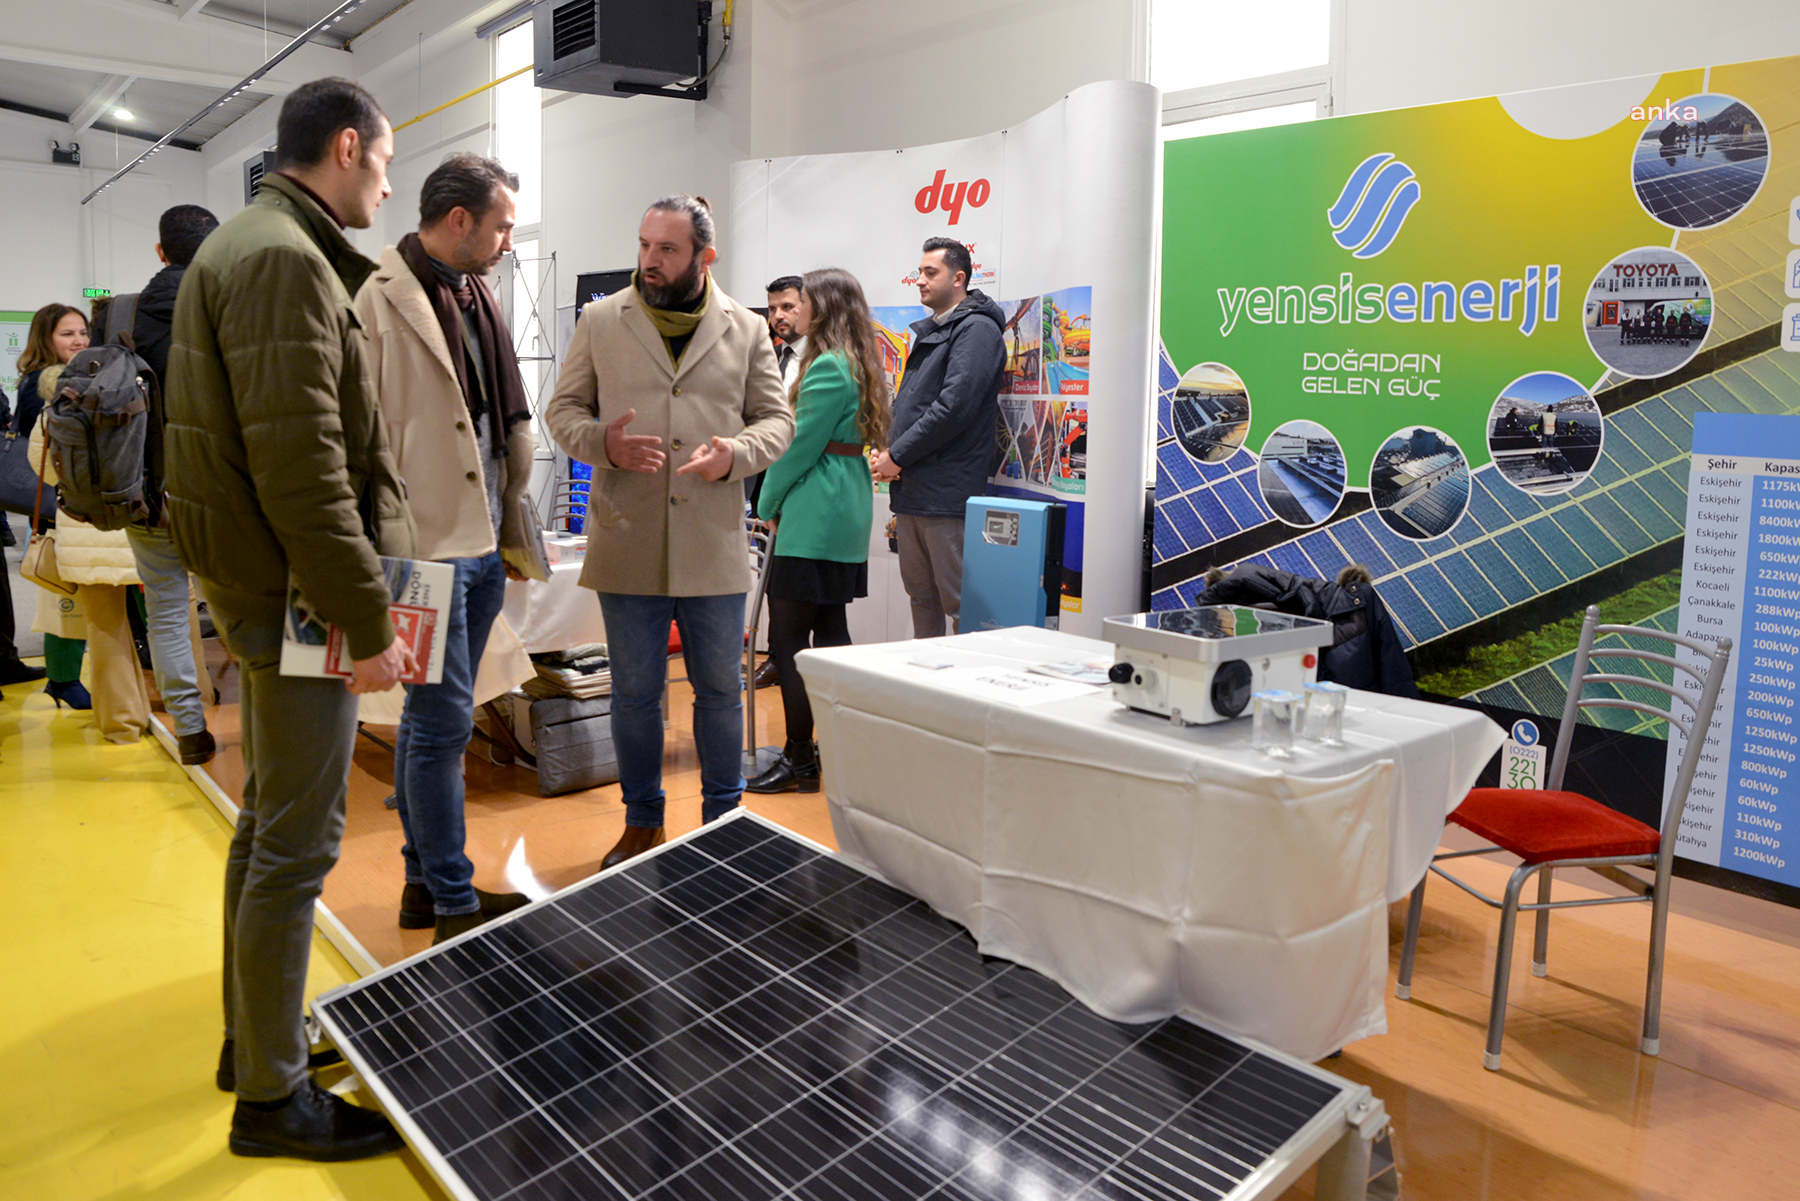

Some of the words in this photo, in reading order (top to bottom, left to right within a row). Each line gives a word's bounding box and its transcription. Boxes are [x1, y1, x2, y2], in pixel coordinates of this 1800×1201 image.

[914, 169, 990, 226] dyo
[1613, 264, 1678, 277] TOYOTA
[1217, 264, 1561, 337] yensisenerji
[1303, 348, 1440, 373] DOĞADAN
[1302, 376, 1380, 396] GELEN
[1388, 376, 1440, 400] GÜÇ
[1708, 458, 1737, 470] Şehir
[1700, 477, 1742, 488] Eskişehir
[1699, 494, 1741, 505] Eskişehir
[1698, 512, 1739, 522] Eskişehir
[1696, 528, 1738, 540] Eskişehir
[1695, 546, 1736, 557] Eskişehir
[1760, 551, 1800, 564] 650kW
[1694, 562, 1735, 574] Eskişehir
[1696, 580, 1730, 591] Kocaeli
[1754, 586, 1800, 600] 1100kW
[1688, 596, 1735, 610] Çanakkale
[1697, 615, 1723, 626] Bursa
[1686, 630, 1729, 642] Adapaz
[1753, 638, 1799, 655] 100kWp
[1754, 656, 1794, 672] 25kWp
[1749, 673, 1796, 690] 250kWp
[1748, 690, 1794, 708] 200kWp
[1746, 708, 1792, 725] 650kWp
[1745, 726, 1798, 744] 1250kWp
[1510, 745, 1539, 760] (0222)
[1743, 743, 1796, 762] 1250kWp
[1510, 756, 1536, 776] 221
[1741, 760, 1787, 779] 800kWp
[1507, 772, 1536, 789] 30
[1739, 778, 1779, 795] 60kWp
[1738, 795, 1777, 812] 60kWp
[1737, 812, 1782, 831] 110kWp
[1676, 834, 1707, 848] ütahya
[1735, 830, 1780, 848] 310kWp
[1733, 847, 1785, 868] 1200kWp
